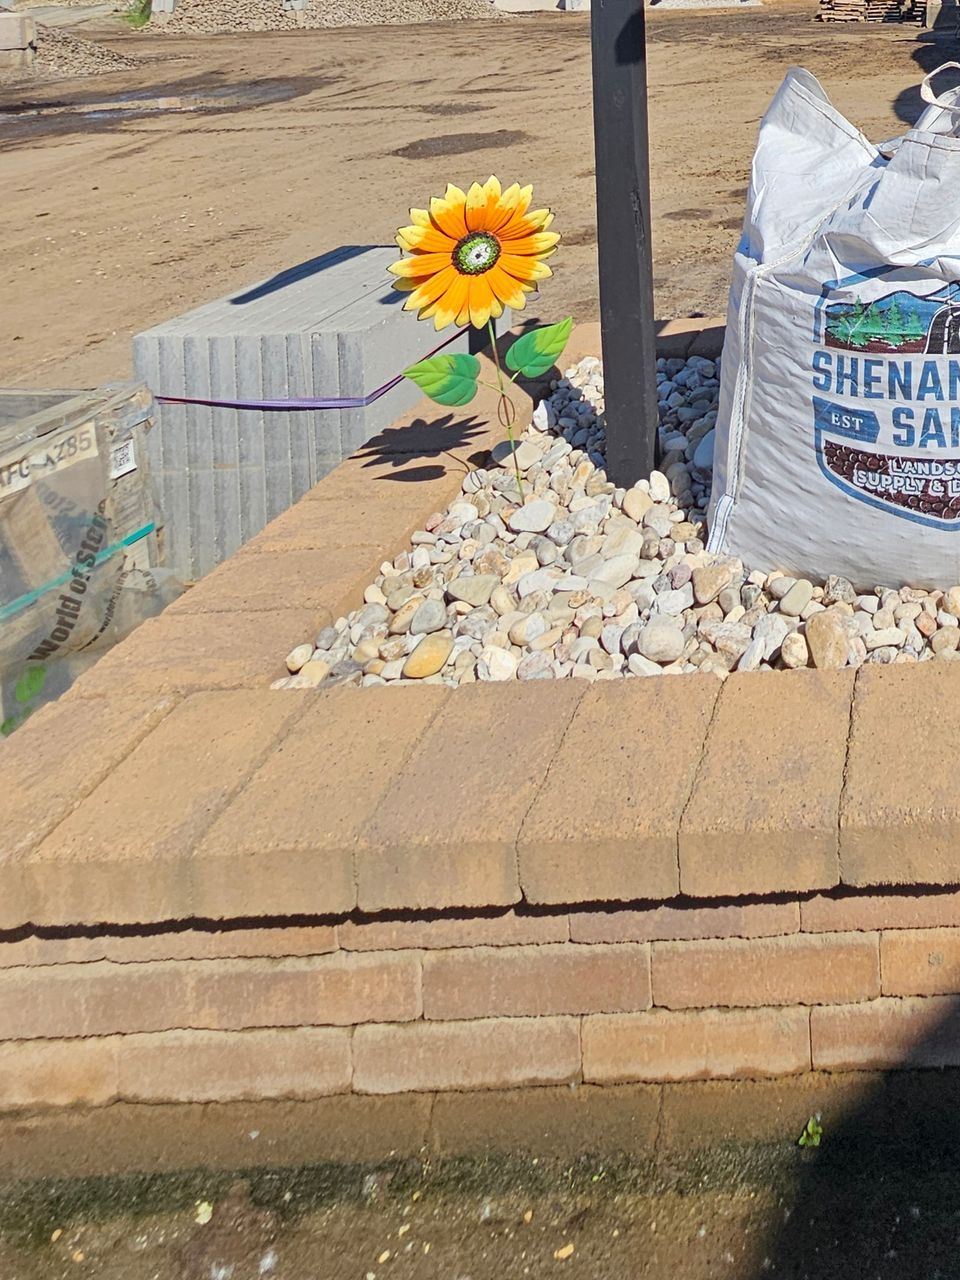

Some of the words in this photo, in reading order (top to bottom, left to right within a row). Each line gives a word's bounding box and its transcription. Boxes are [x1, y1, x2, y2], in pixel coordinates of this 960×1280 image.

[831, 413, 864, 431] EST
[854, 470, 925, 494] SUPPLY
[928, 477, 945, 495] &
[26, 594, 82, 661] World
[69, 567, 91, 595] of
